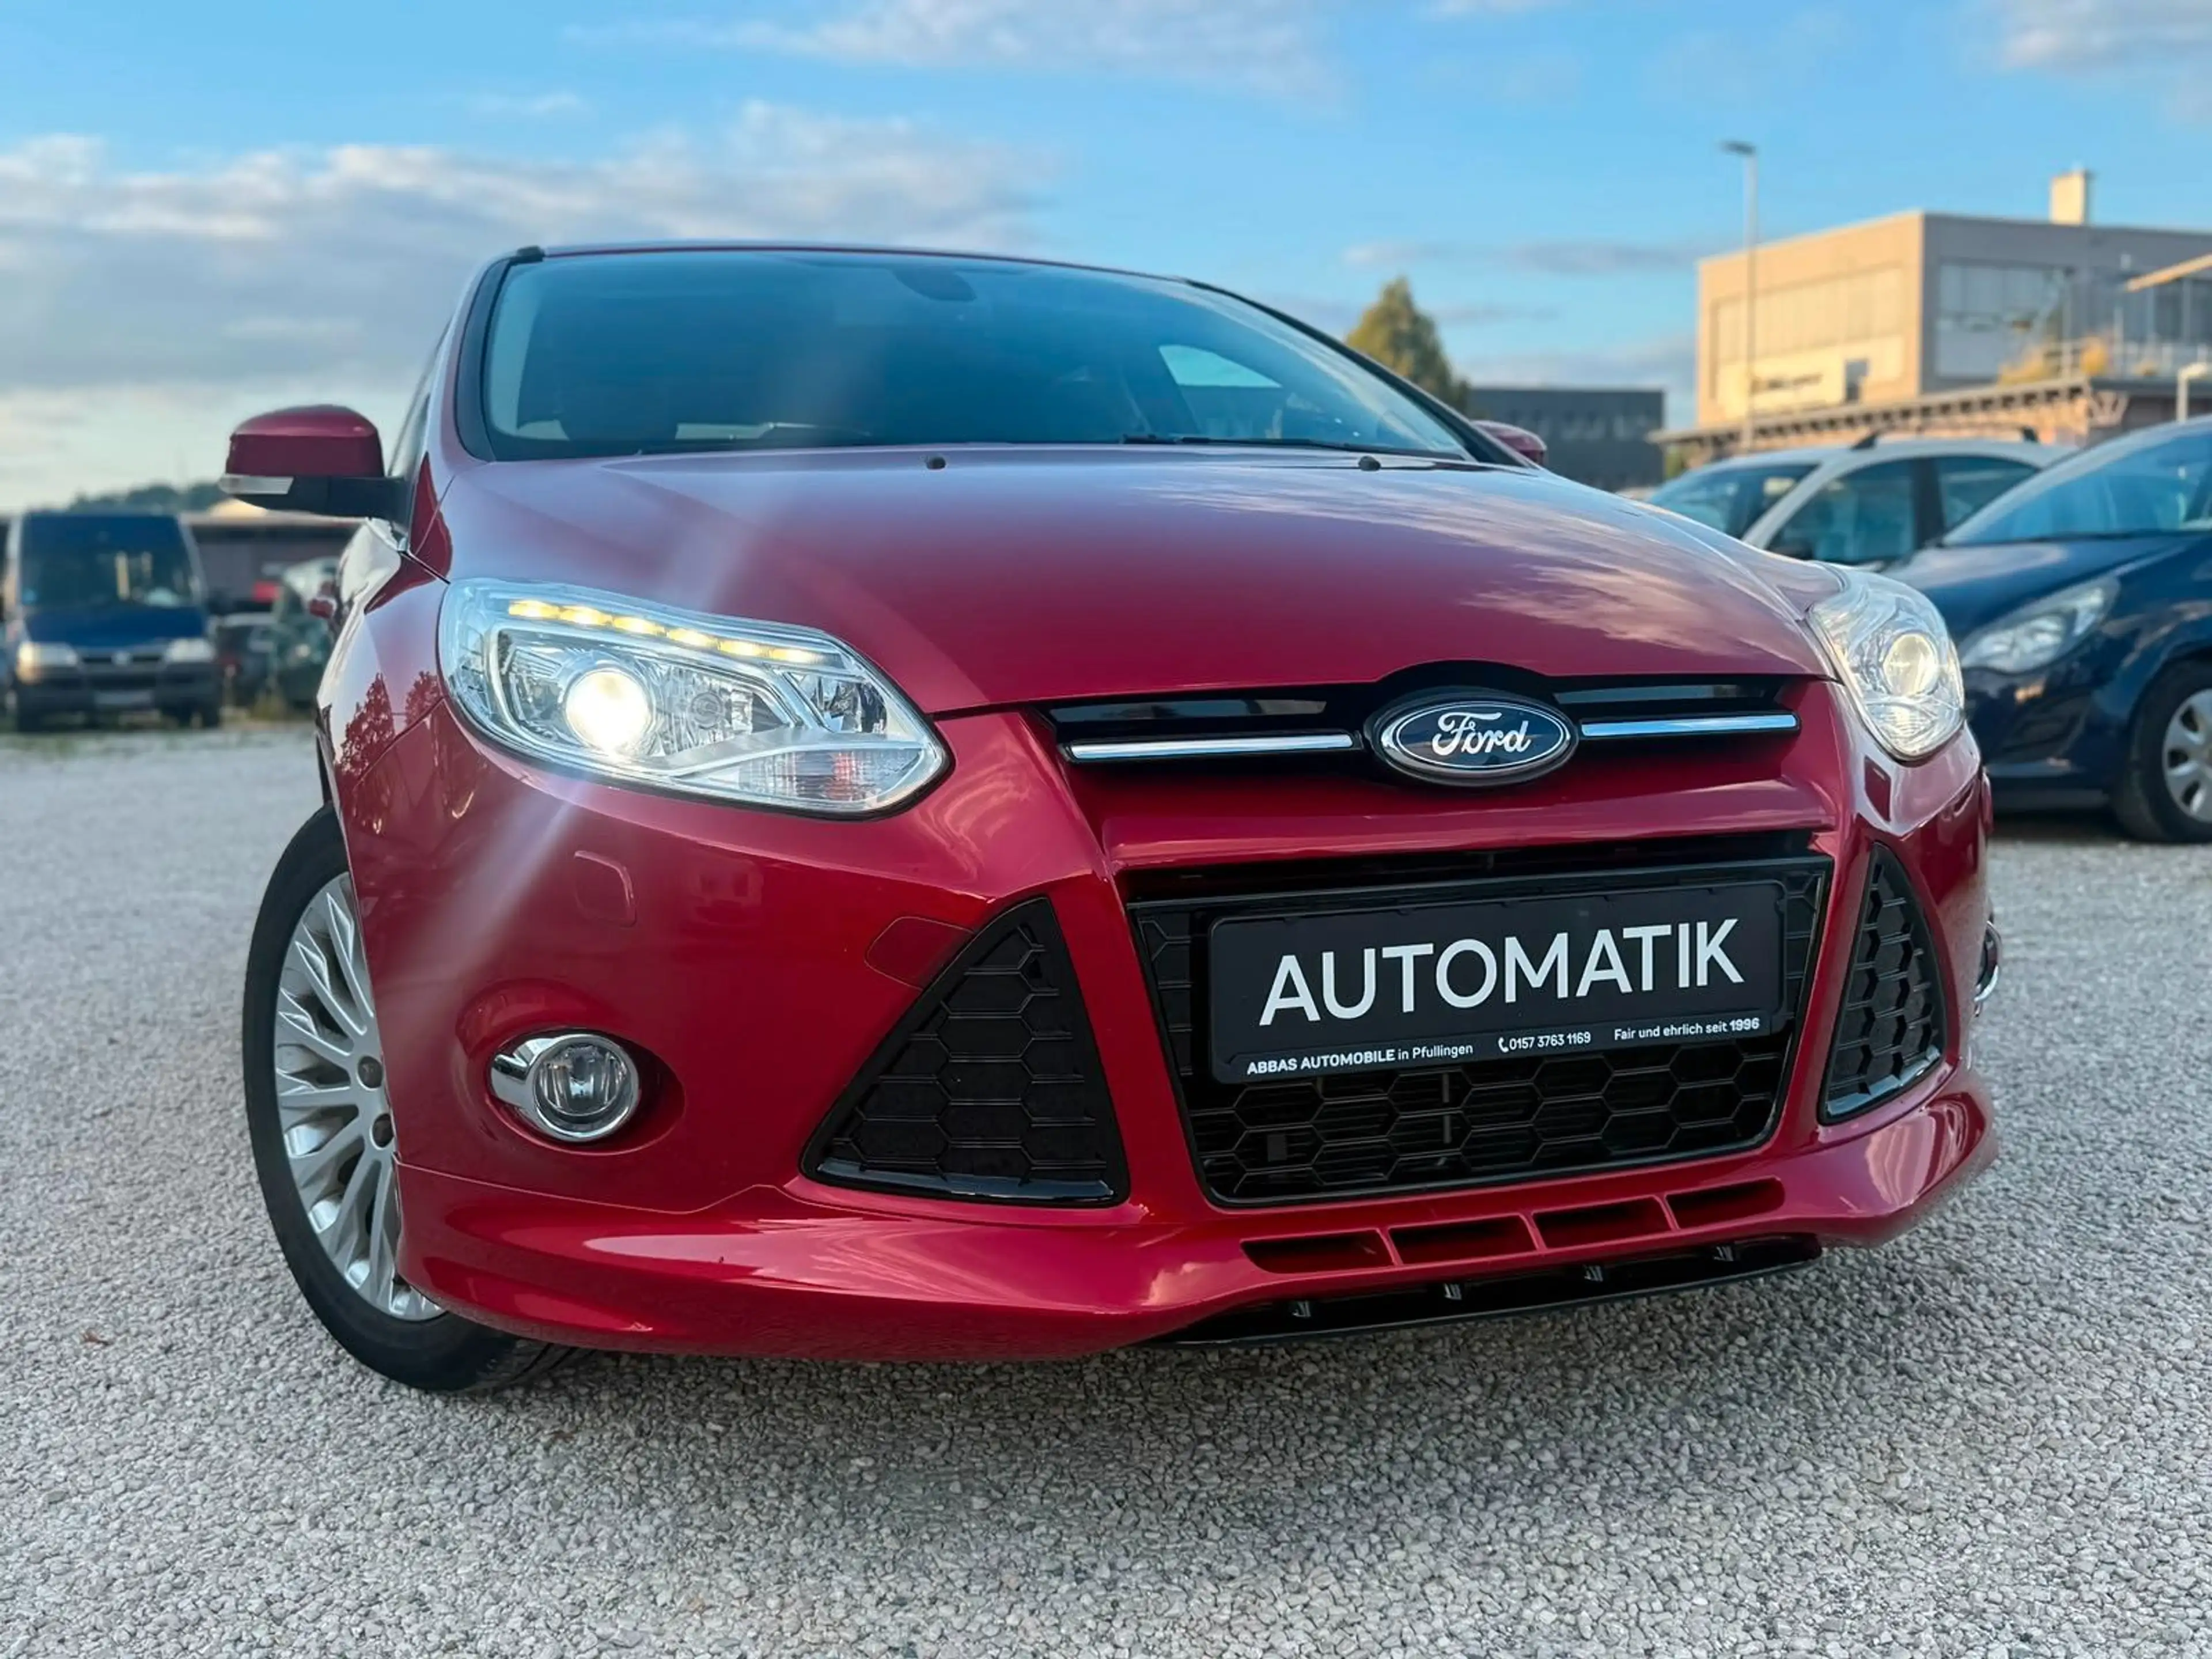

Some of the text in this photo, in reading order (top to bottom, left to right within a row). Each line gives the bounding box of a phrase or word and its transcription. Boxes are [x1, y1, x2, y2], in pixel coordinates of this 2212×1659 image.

[1432, 711, 1531, 756] Ford
[1259, 918, 1744, 1026] AUTOMATIK
[1509, 1031, 1591, 1051] 0157 3763 1169
[1614, 1017, 1760, 1040] Fair und ehrlich seit 1996
[1247, 1044, 1474, 1075] ABBAS AUTOMOBILE in Pfullingen
